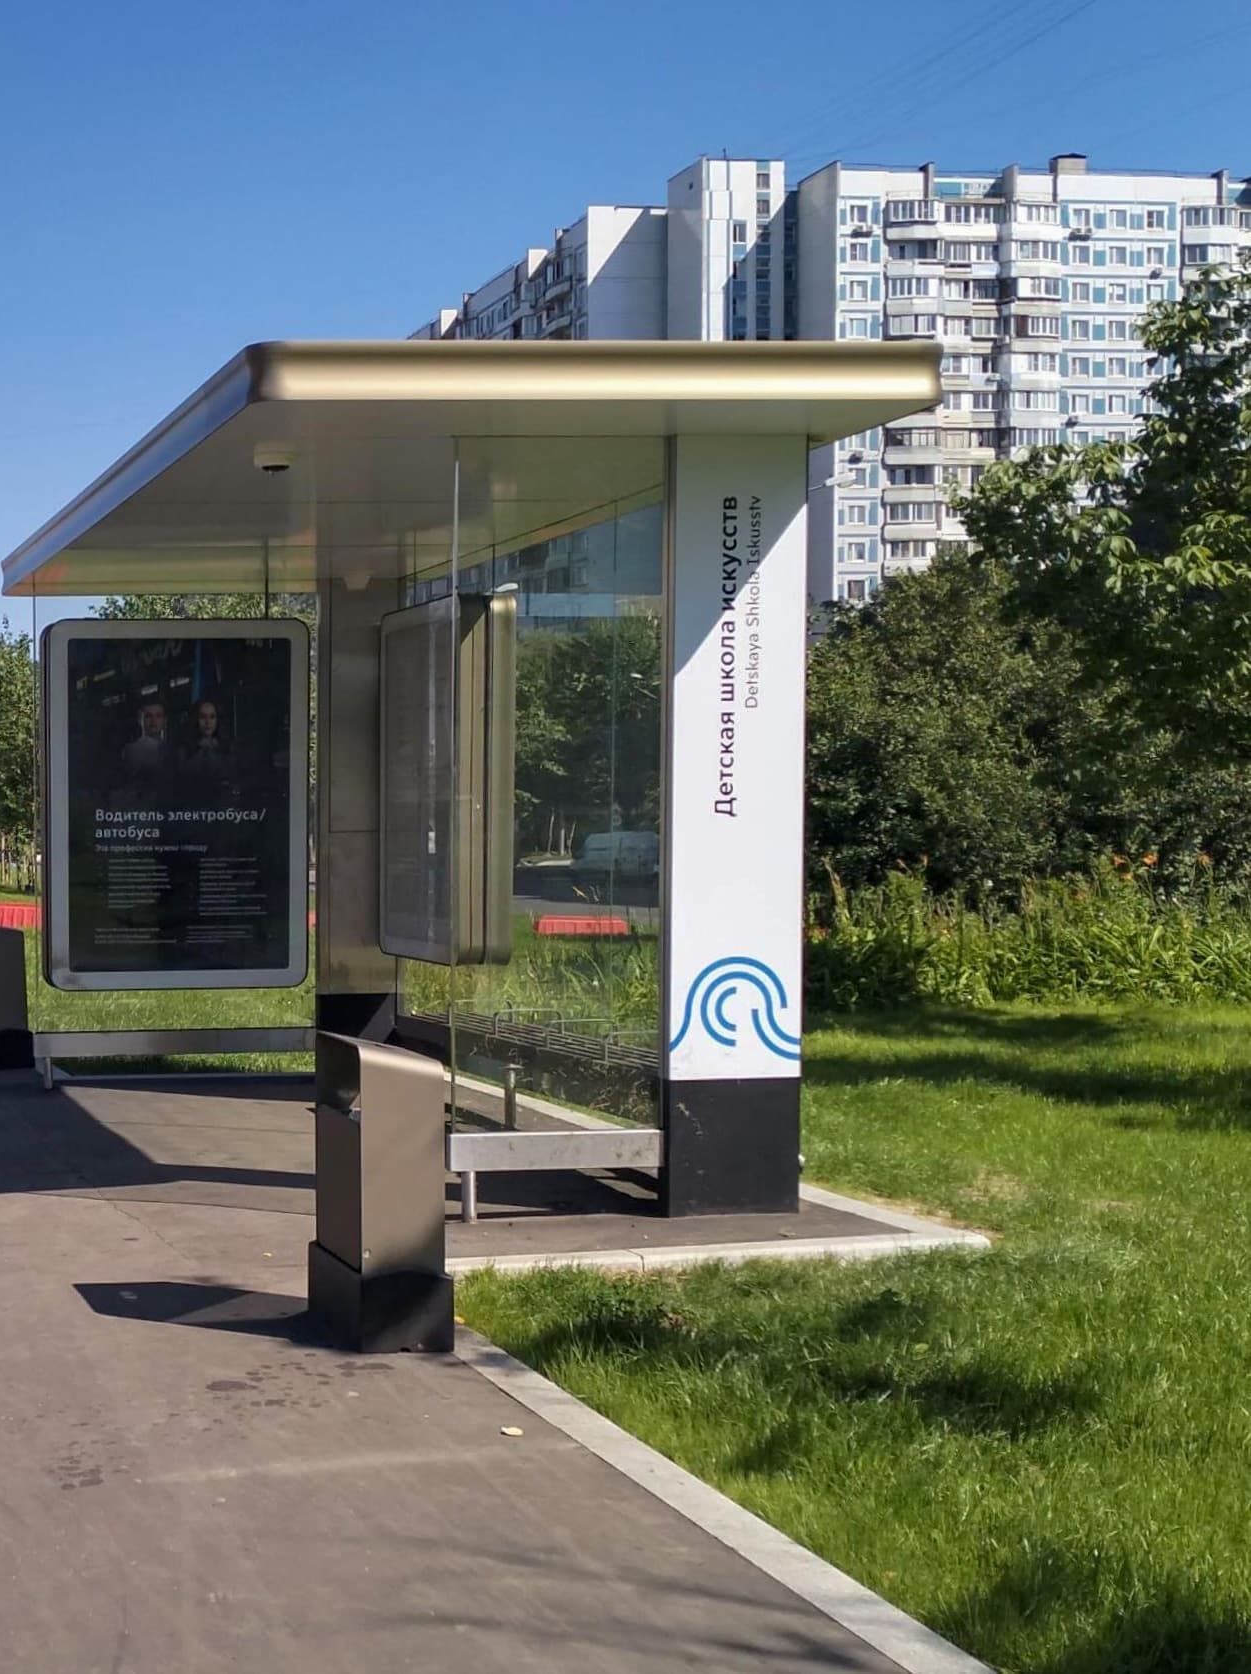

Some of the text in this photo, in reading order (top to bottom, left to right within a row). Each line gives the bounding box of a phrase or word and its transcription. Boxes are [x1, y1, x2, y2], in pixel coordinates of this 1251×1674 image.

[714, 496, 742, 817] Детская школа искусств
[744, 495, 763, 709] Detskaya Shkola Iskusstv
[95, 808, 266, 824] Водитель электробуса/
[95, 825, 160, 841] автобуса
